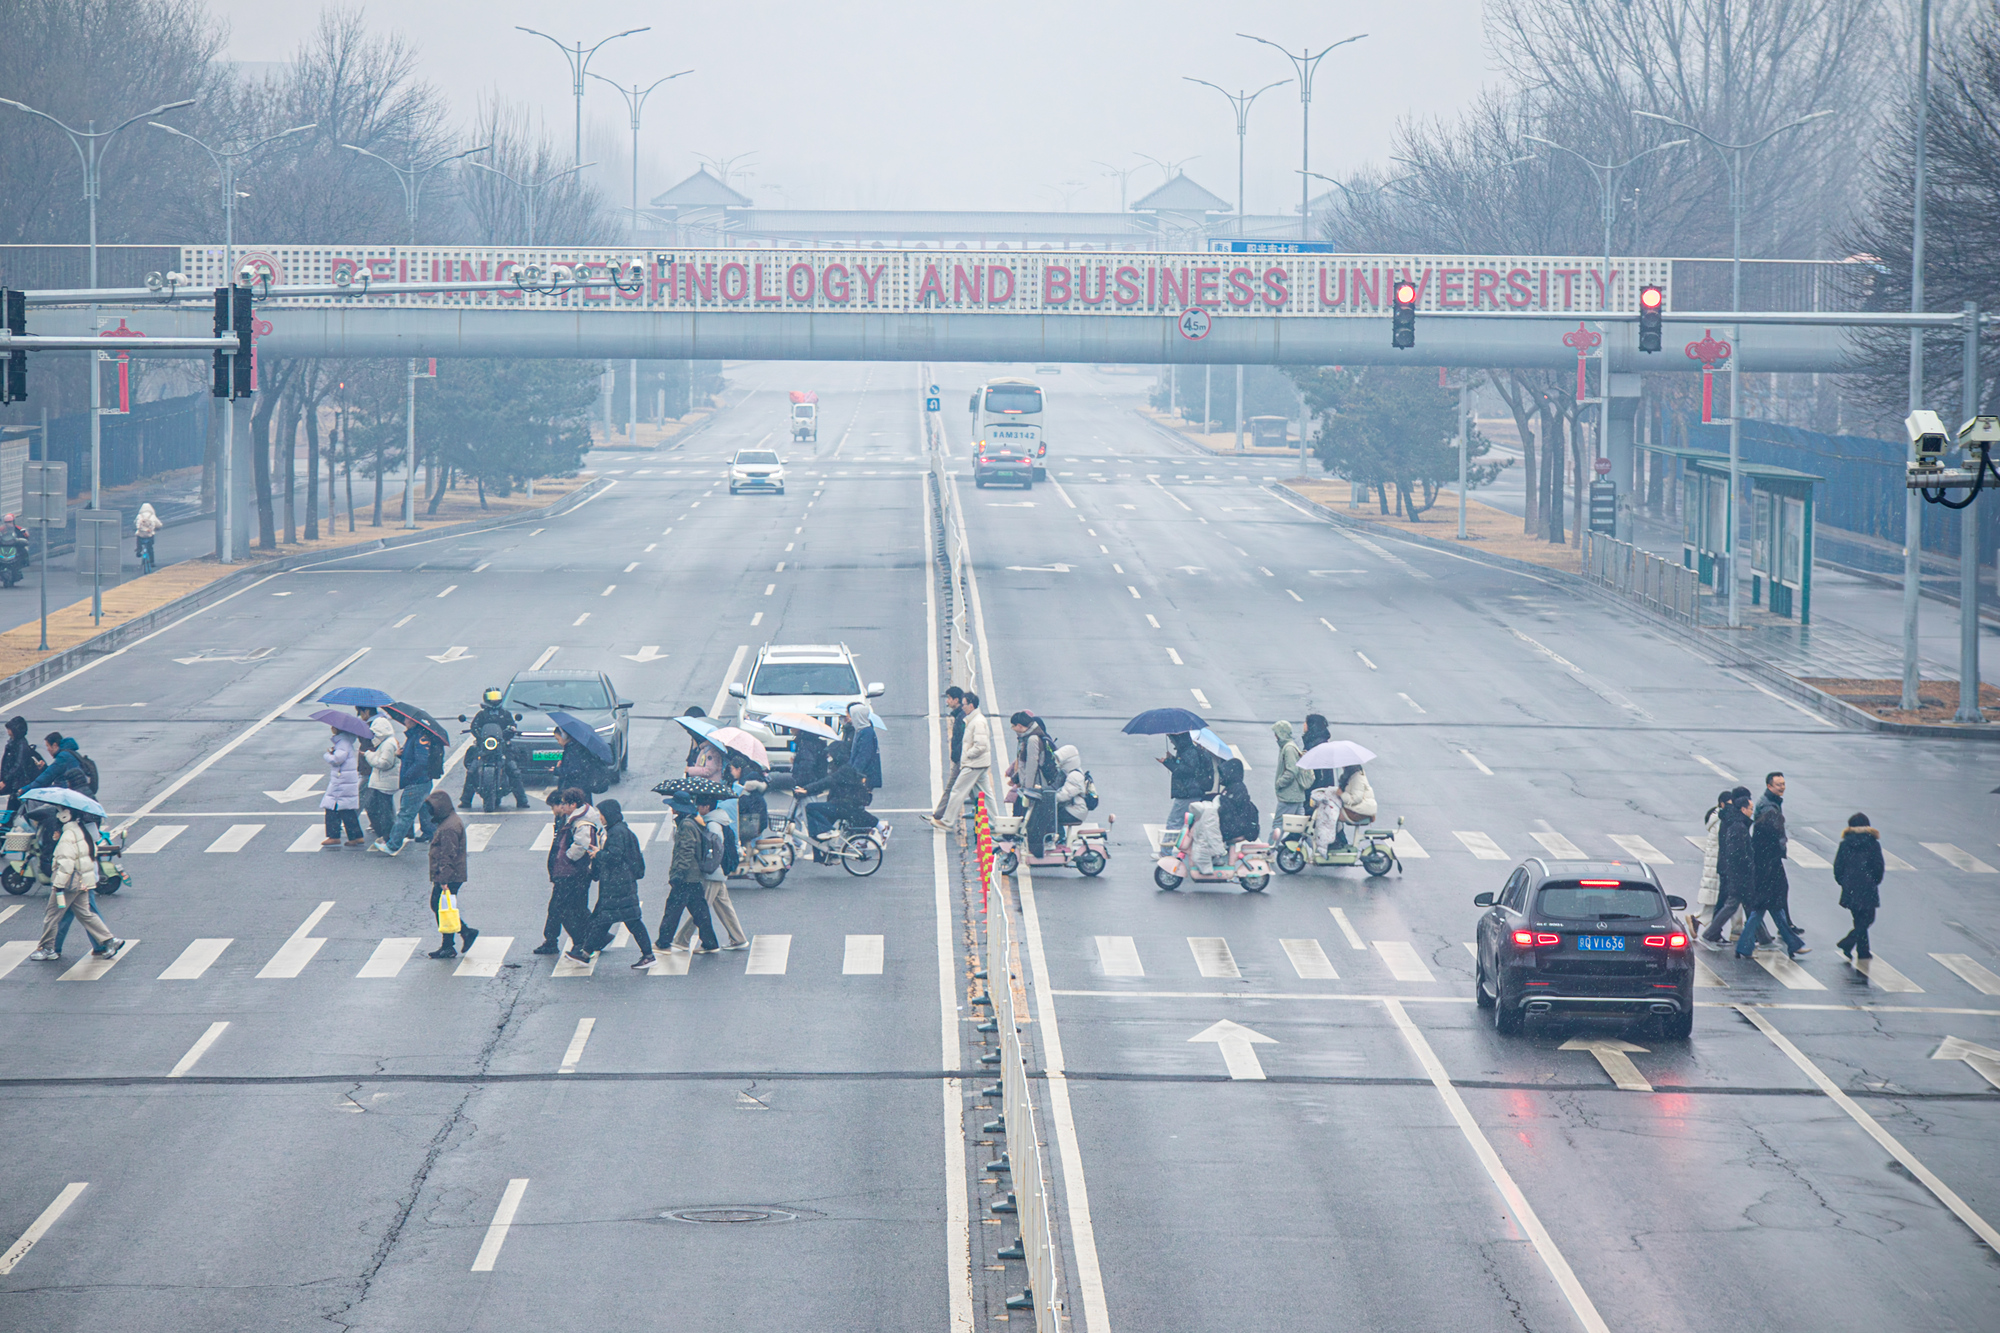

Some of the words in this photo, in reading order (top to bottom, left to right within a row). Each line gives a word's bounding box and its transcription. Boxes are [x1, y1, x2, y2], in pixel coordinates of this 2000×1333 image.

[917, 264, 1015, 304] AND
[1044, 265, 1288, 307] BUSINESS
[1318, 267, 1618, 309] UNIVERSITY
